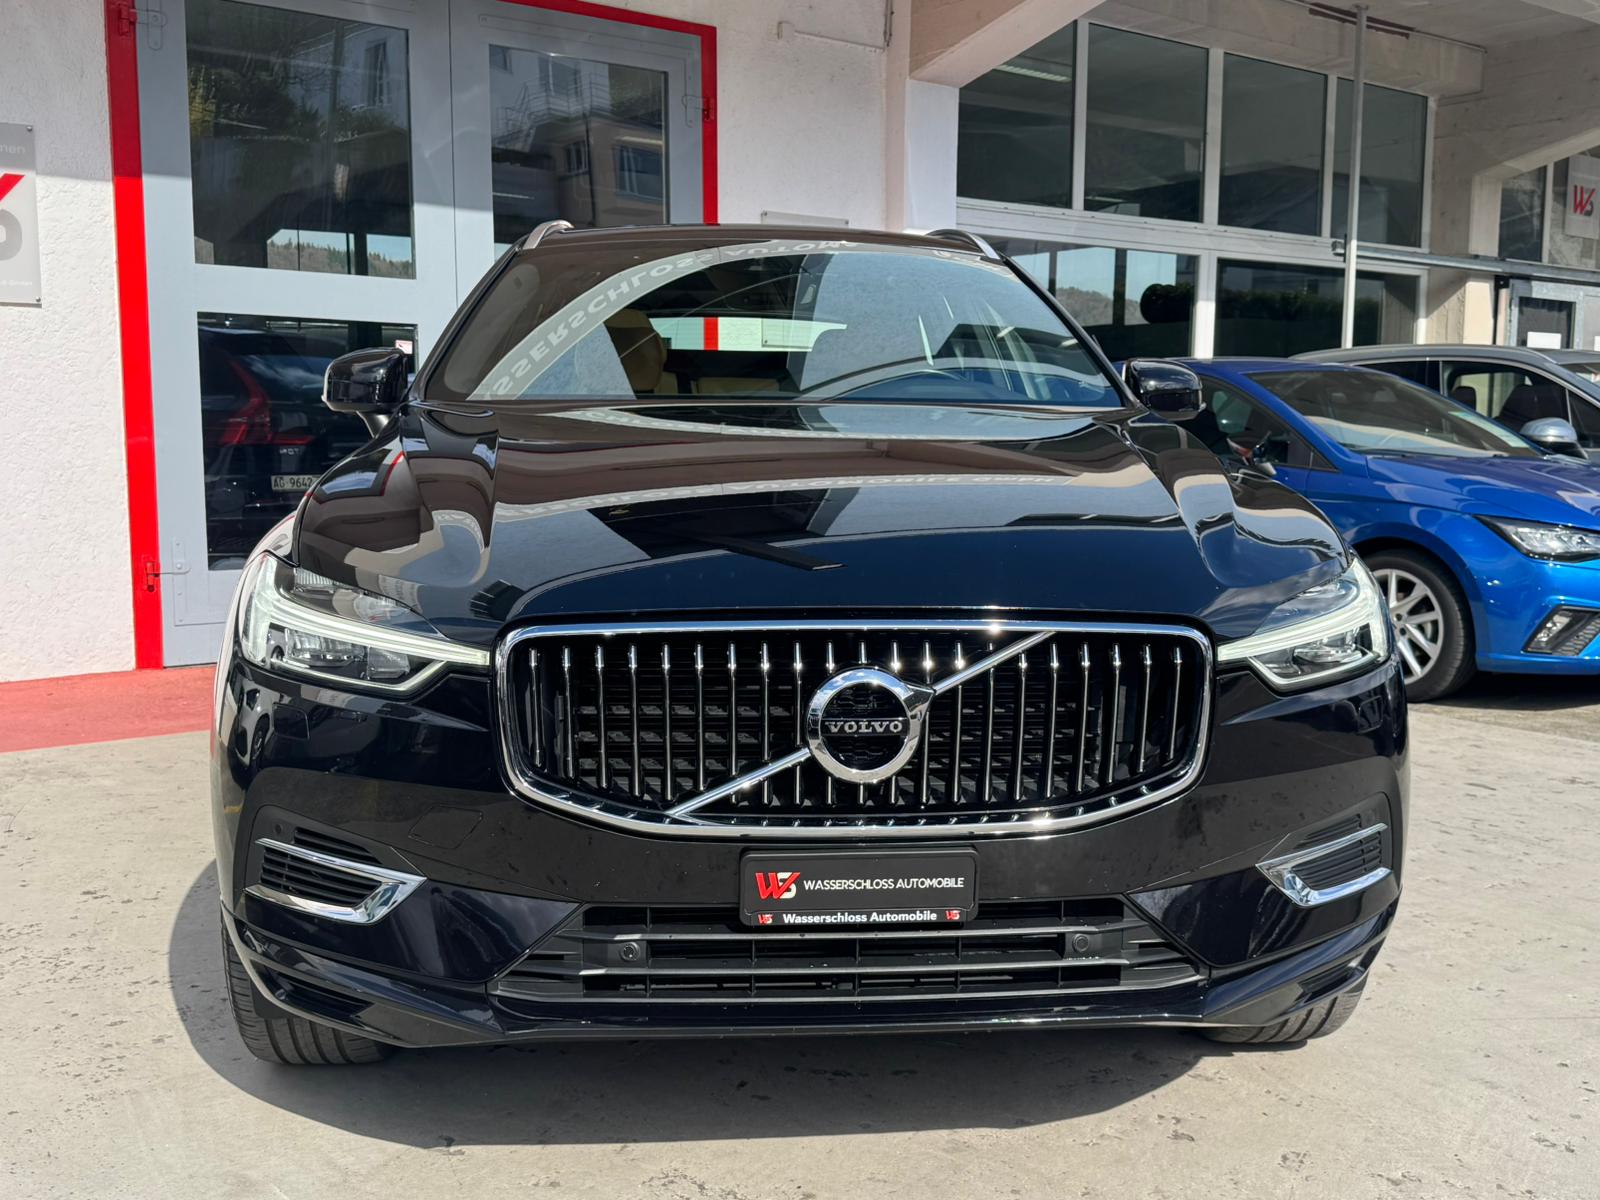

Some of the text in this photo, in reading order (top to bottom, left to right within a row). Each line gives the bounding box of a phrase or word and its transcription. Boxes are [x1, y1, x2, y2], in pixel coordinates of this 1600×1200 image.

[825, 720, 903, 733] VOLVO
[803, 877, 965, 890] WASSERSCHLOSS AUTOMOBILE
[782, 912, 868, 924] Wasserschloss
[869, 910, 938, 922] Automobile
